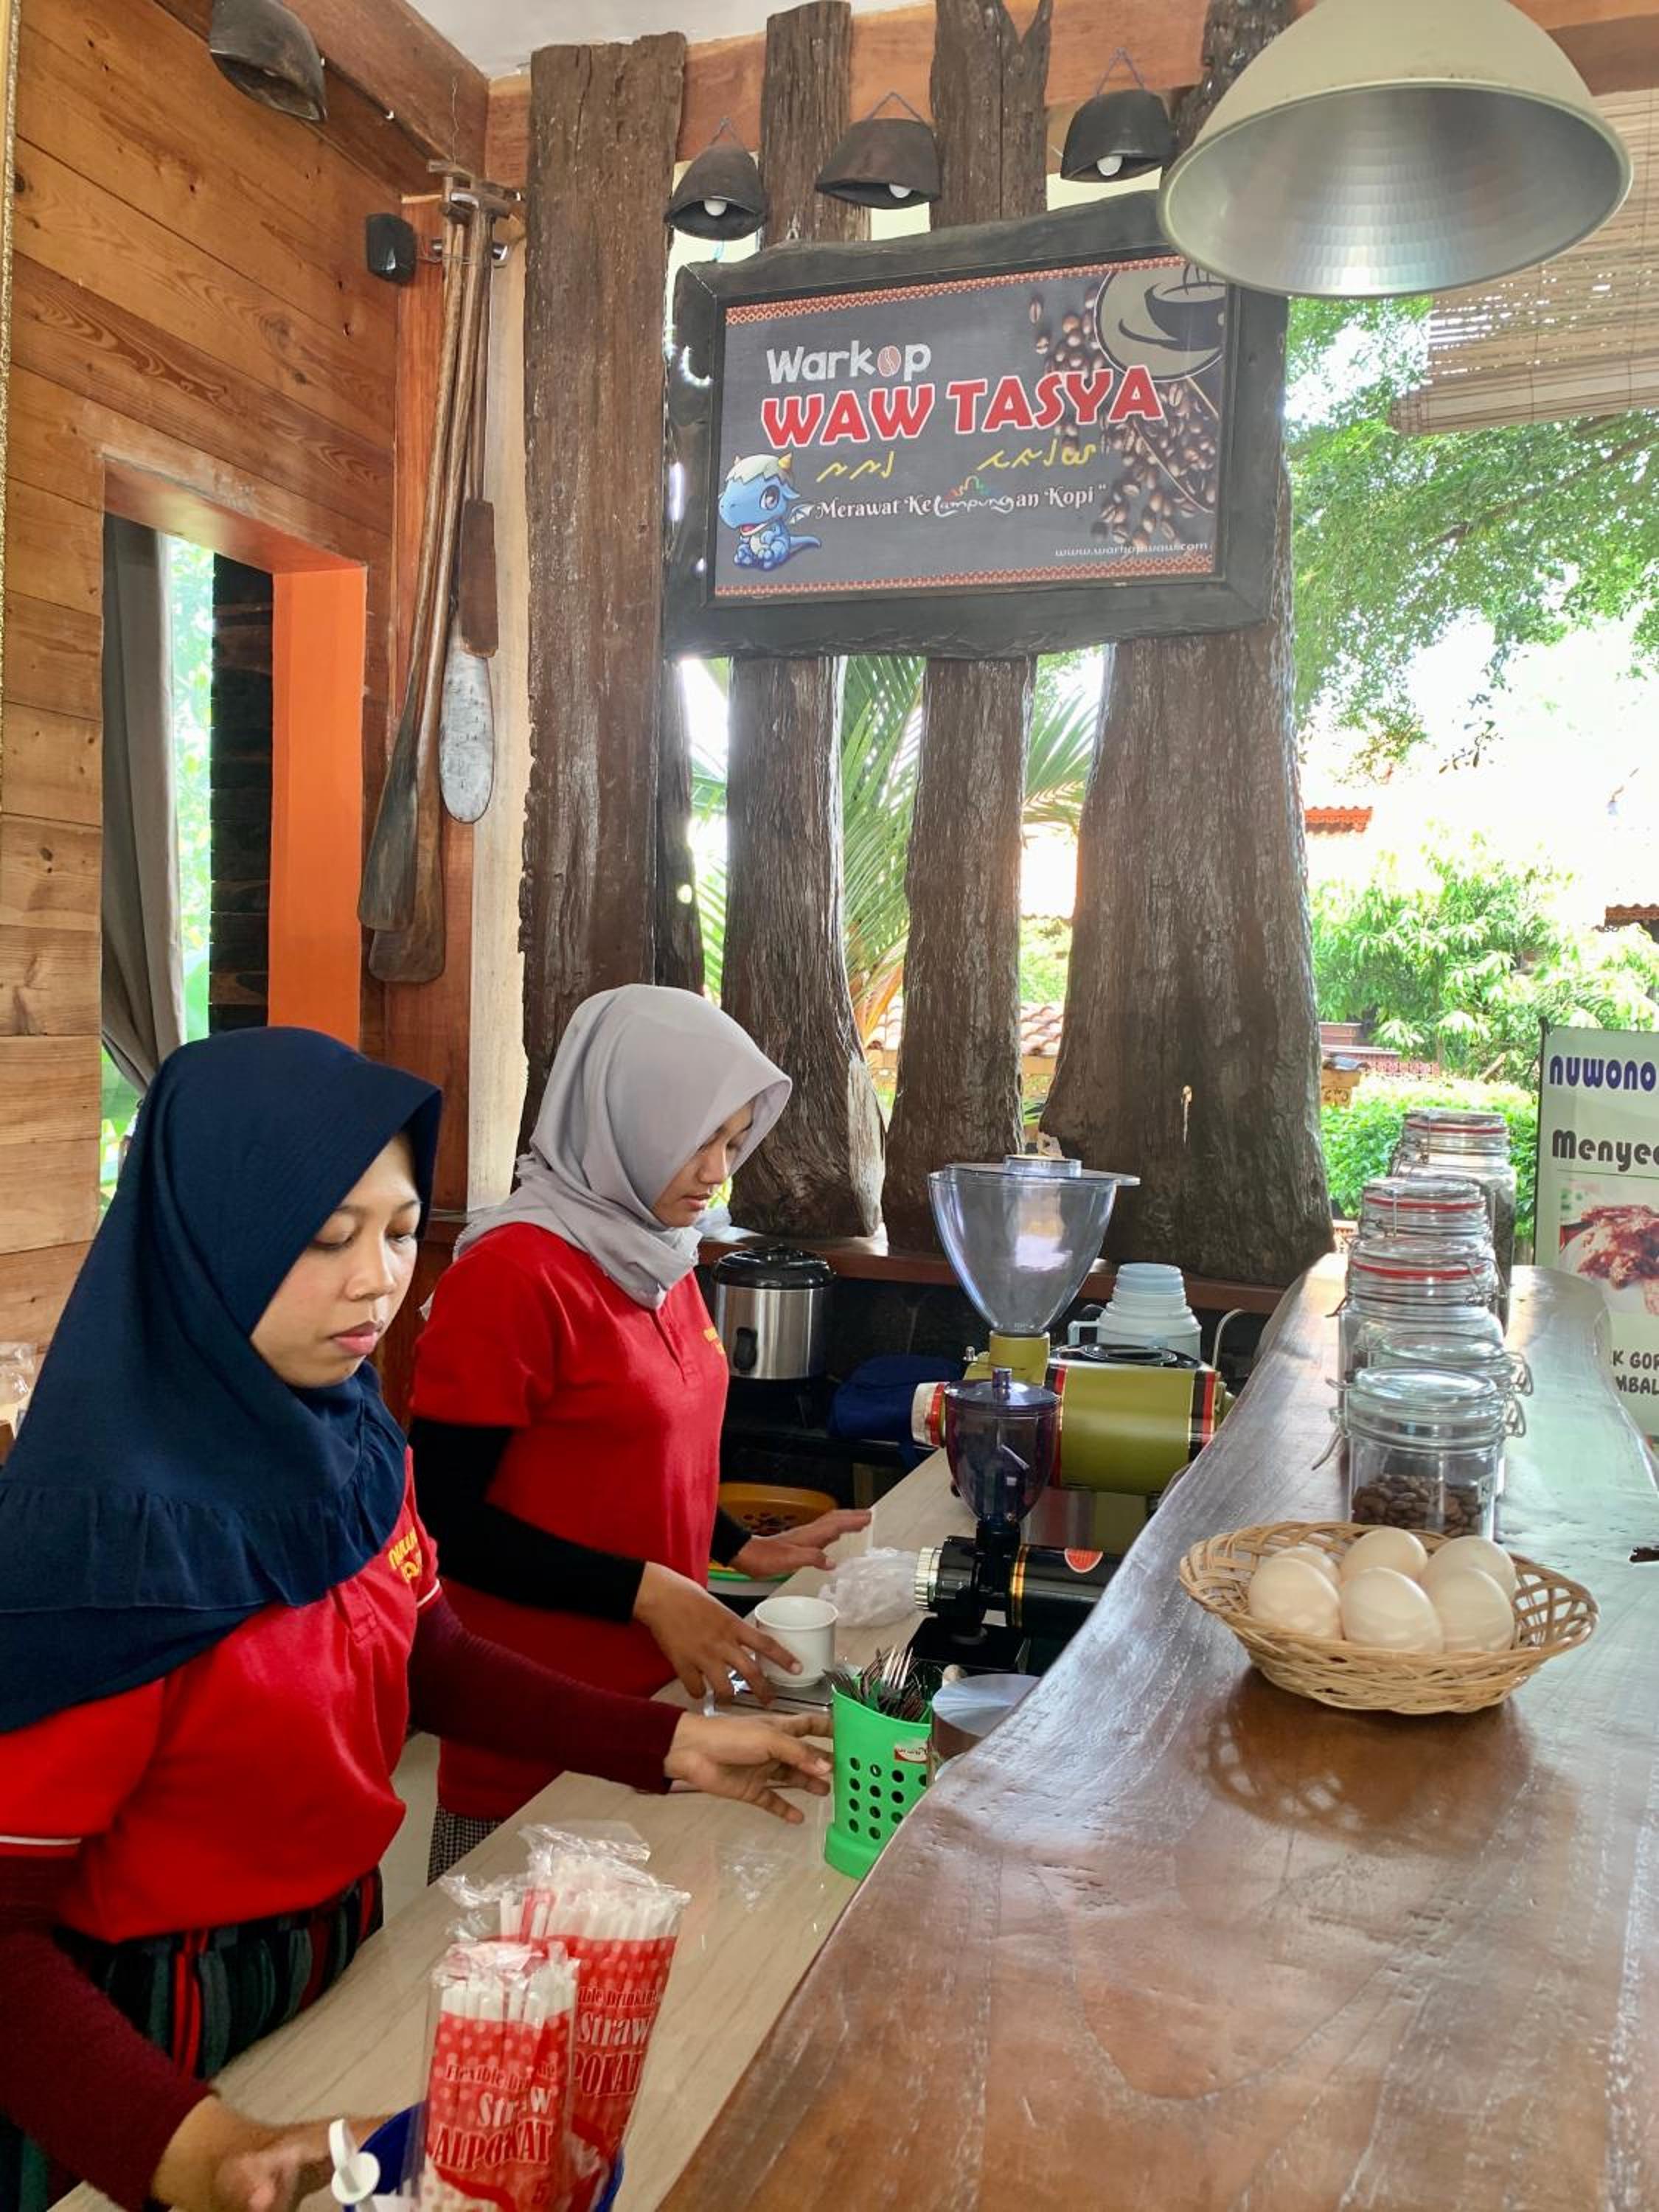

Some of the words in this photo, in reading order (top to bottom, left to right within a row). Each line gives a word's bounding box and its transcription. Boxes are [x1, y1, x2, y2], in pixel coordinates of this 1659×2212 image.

[766, 340, 932, 384] Warkop
[761, 383, 935, 449] WAW
[946, 365, 1165, 434] TASYA
[816, 496, 900, 519] Merawat
